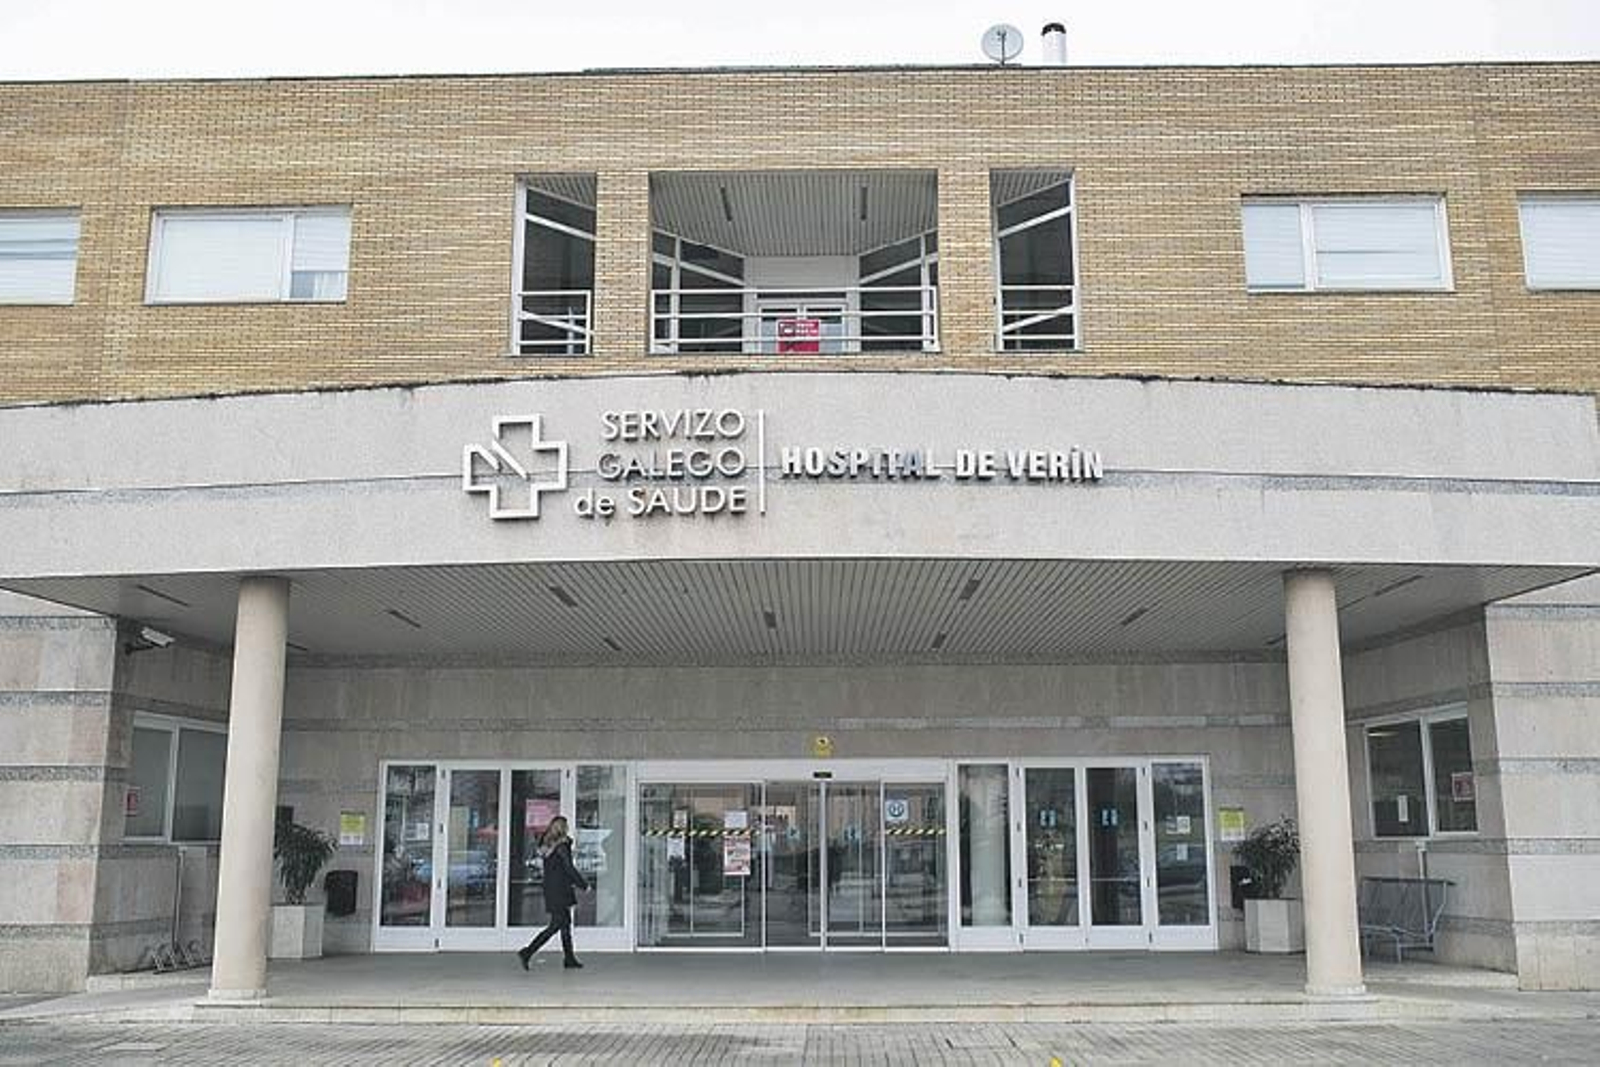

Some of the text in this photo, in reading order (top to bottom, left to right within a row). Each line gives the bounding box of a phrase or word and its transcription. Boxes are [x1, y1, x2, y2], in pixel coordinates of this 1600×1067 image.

[601, 408, 746, 440] SERVIZO
[597, 447, 746, 479] GALEGO
[781, 446, 942, 479] HOSPITAL
[955, 448, 997, 479] DE
[574, 485, 747, 516] de SAUDE
